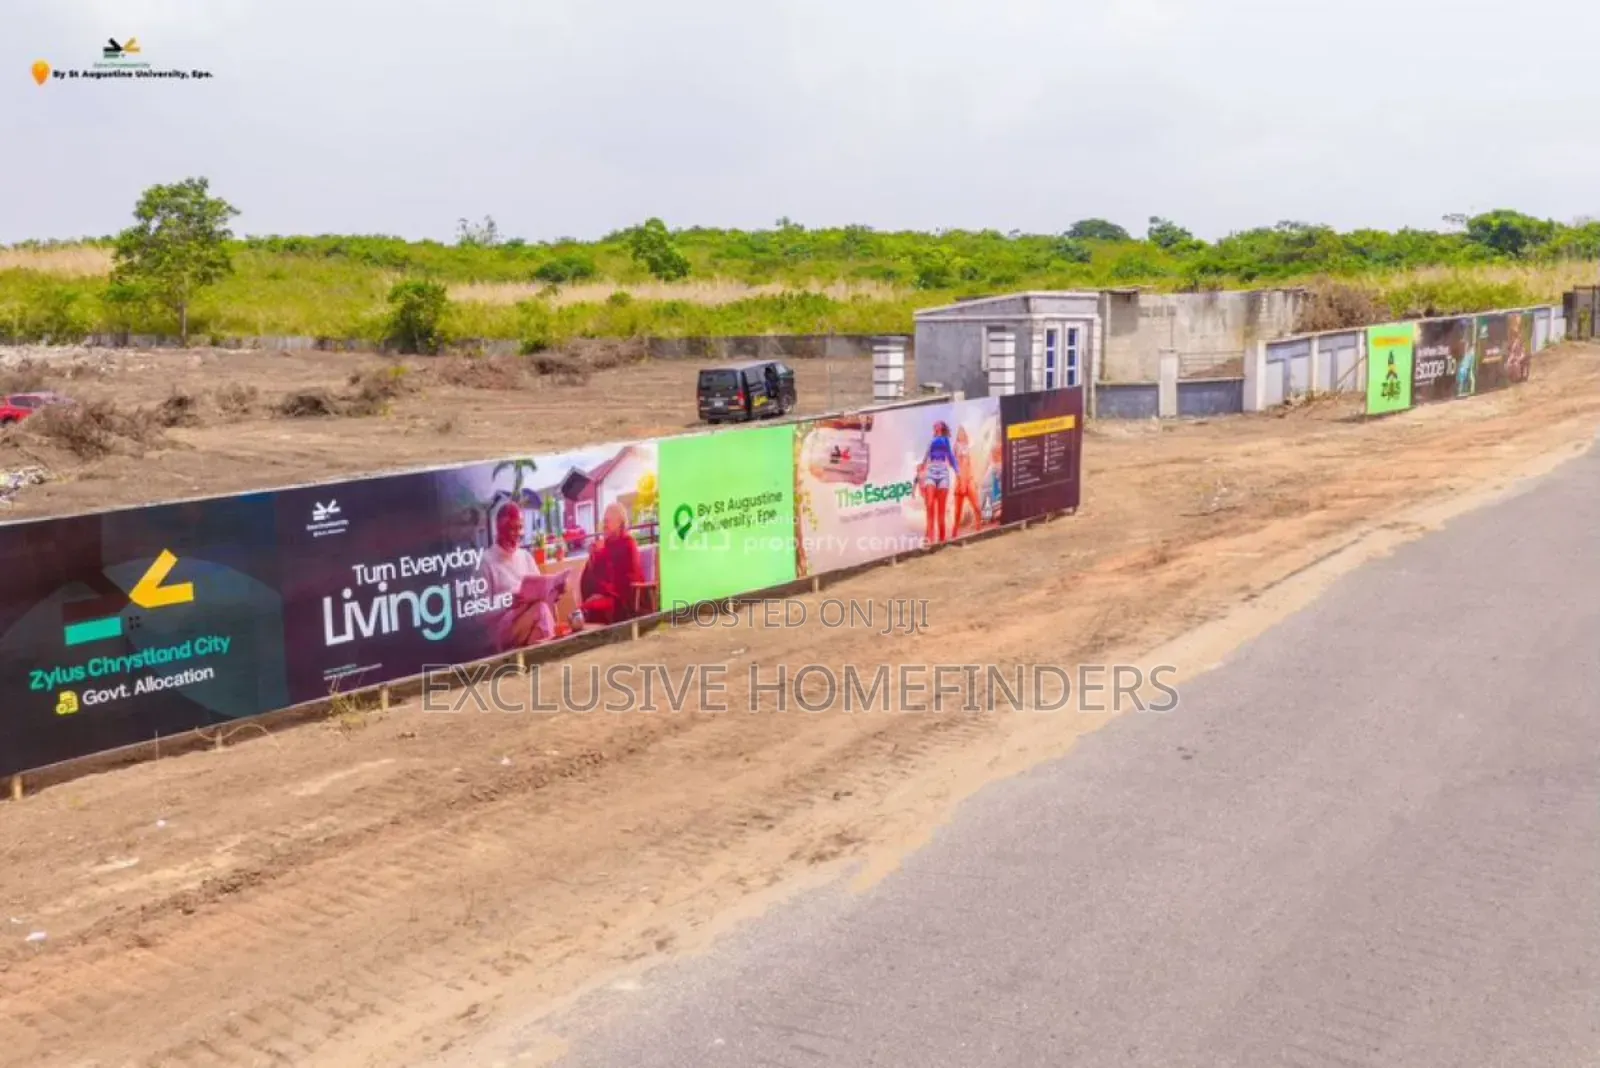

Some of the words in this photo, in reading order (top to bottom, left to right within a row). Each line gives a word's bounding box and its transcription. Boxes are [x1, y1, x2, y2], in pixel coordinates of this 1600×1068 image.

[697, 502, 712, 517] By
[714, 500, 725, 514] St
[727, 491, 783, 513] Augustine
[834, 488, 861, 508] The
[863, 481, 913, 504] Escape
[757, 508, 777, 525] Epe
[352, 563, 397, 587] Turn
[399, 546, 485, 578] Everyday
[454, 576, 489, 600] Into
[322, 581, 454, 647] Living
[456, 591, 514, 619] Leisure
[28, 663, 86, 692] Zylus
[87, 640, 192, 679] Chrystland
[194, 634, 232, 656] City
[82, 683, 131, 706] Govt.
[134, 666, 215, 696] Allocation
